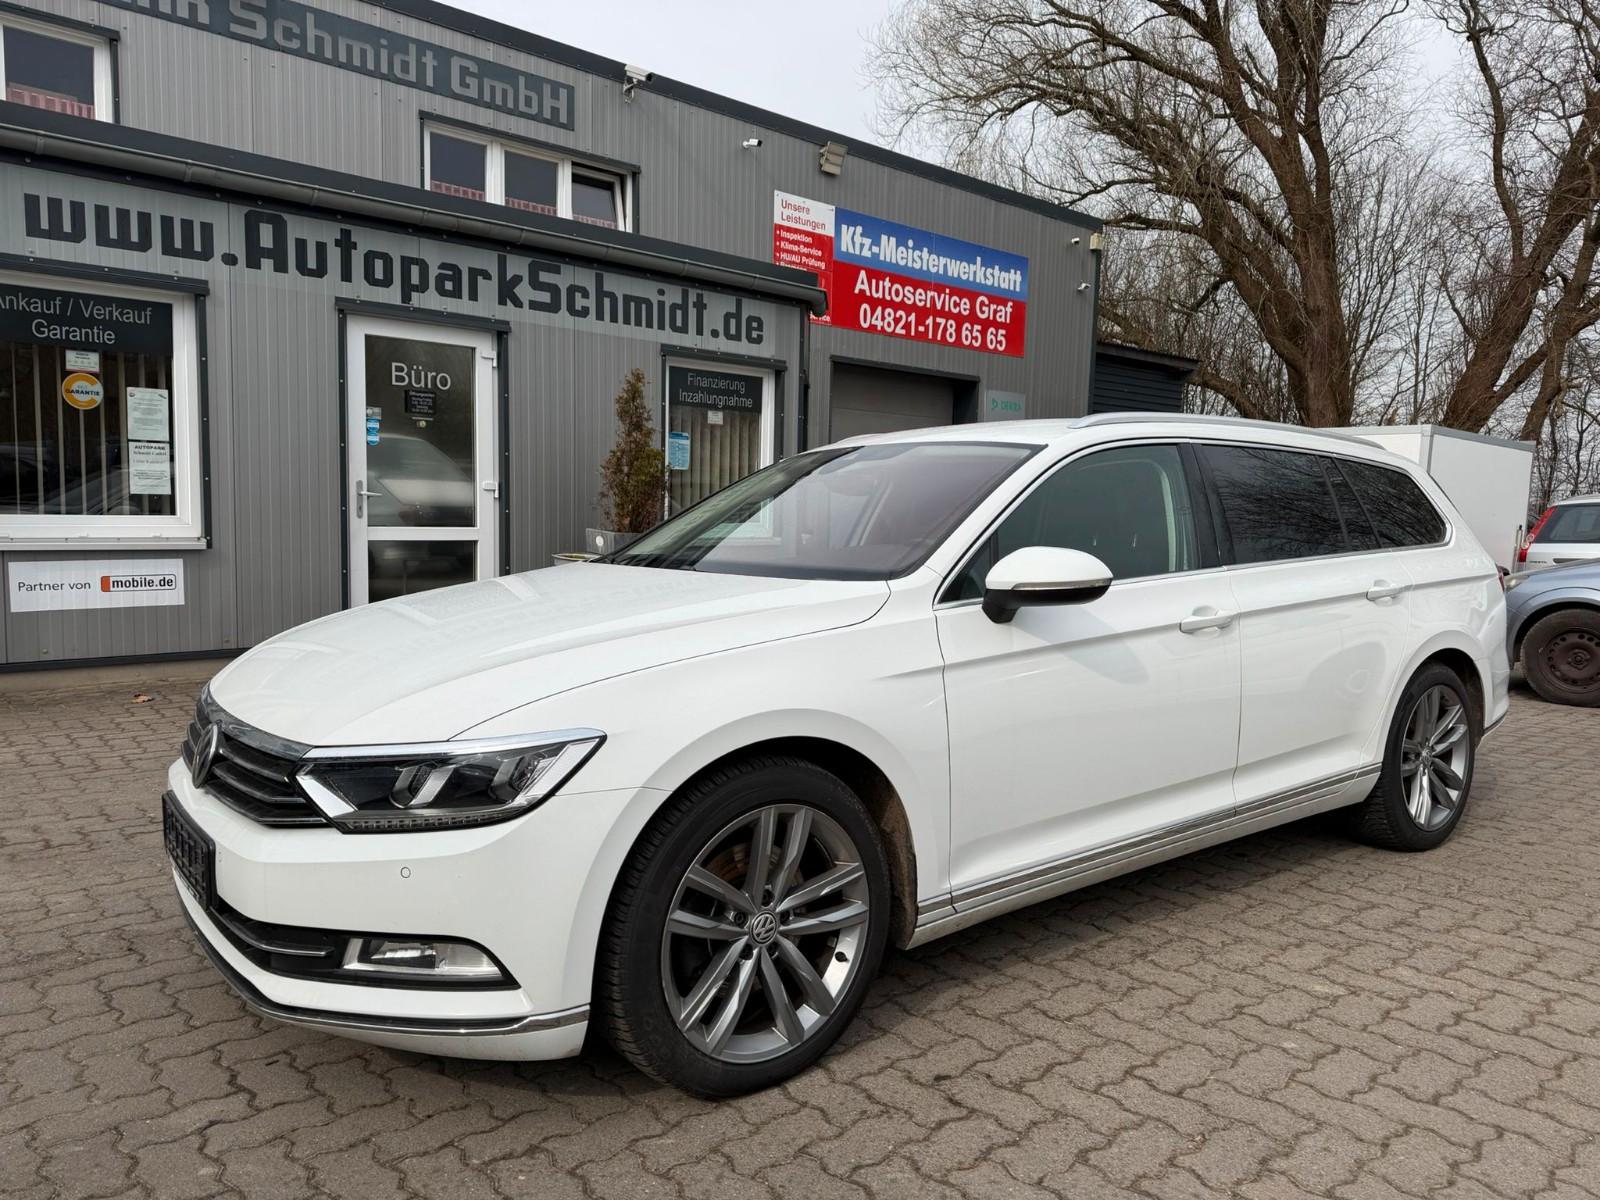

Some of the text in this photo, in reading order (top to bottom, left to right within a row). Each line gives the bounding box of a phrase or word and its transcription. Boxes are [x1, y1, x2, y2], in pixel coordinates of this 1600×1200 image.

[229, 0, 568, 124] Schmidt GmbH
[781, 198, 811, 215] Unsere
[781, 210, 826, 231] Leistungen
[780, 229, 813, 244] Inspektion
[780, 240, 823, 257] Klima-Service
[841, 223, 1022, 292] Kfz-Meisterwerkstatt
[24, 192, 764, 345] www.AutoparkSchmidt.de
[780, 251, 801, 264] HU/AU
[801, 256, 826, 270] Prüfung
[854, 269, 1013, 324] Autoservice Graf
[80, 299, 152, 325] Verkauf
[31, 318, 116, 345] Garantie
[859, 303, 956, 344] 04821-178
[961, 322, 982, 348] 65
[986, 327, 1007, 352] 65
[391, 361, 452, 391] Büro
[687, 372, 746, 394] Finanzierung
[65, 388, 100, 396] GARANTIE
[680, 388, 753, 408] Inzahlungnahme
[18, 576, 174, 592] Partner von mobile.de
